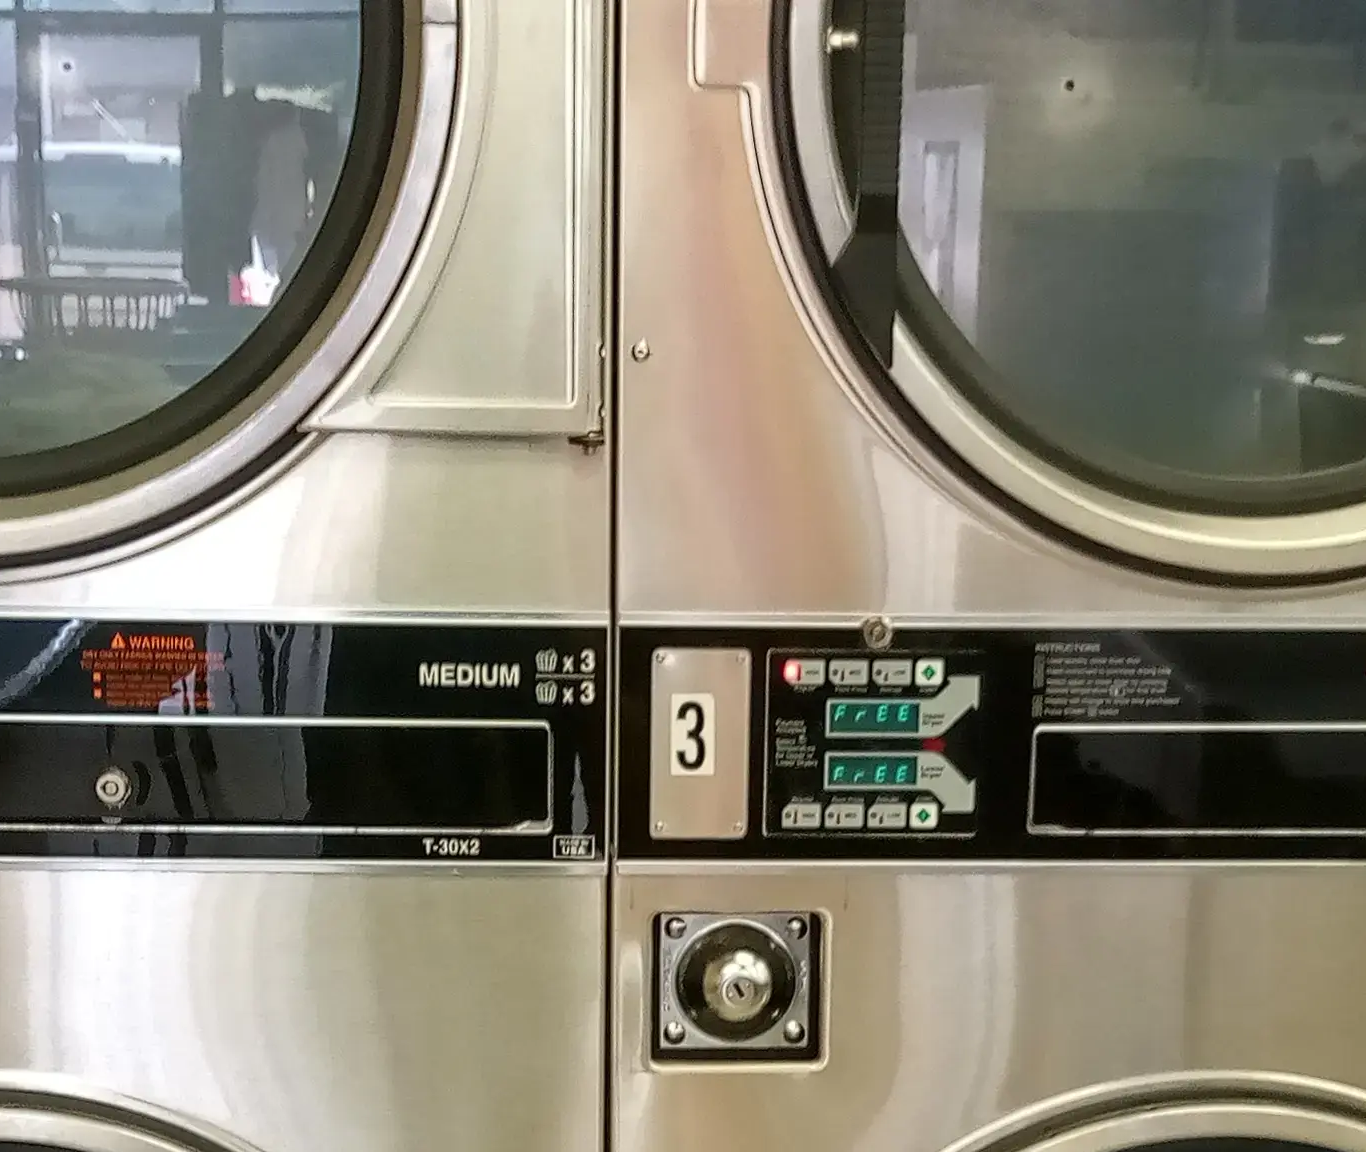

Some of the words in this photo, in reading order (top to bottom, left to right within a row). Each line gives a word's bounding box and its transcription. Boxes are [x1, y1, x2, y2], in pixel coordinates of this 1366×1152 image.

[129, 635, 195, 650] WARNING
[580, 648, 596, 673] 3
[418, 662, 521, 687] MEDIUM
[580, 680, 596, 705] 3
[675, 701, 706, 772] 3
[422, 838, 481, 856] T-30X2
